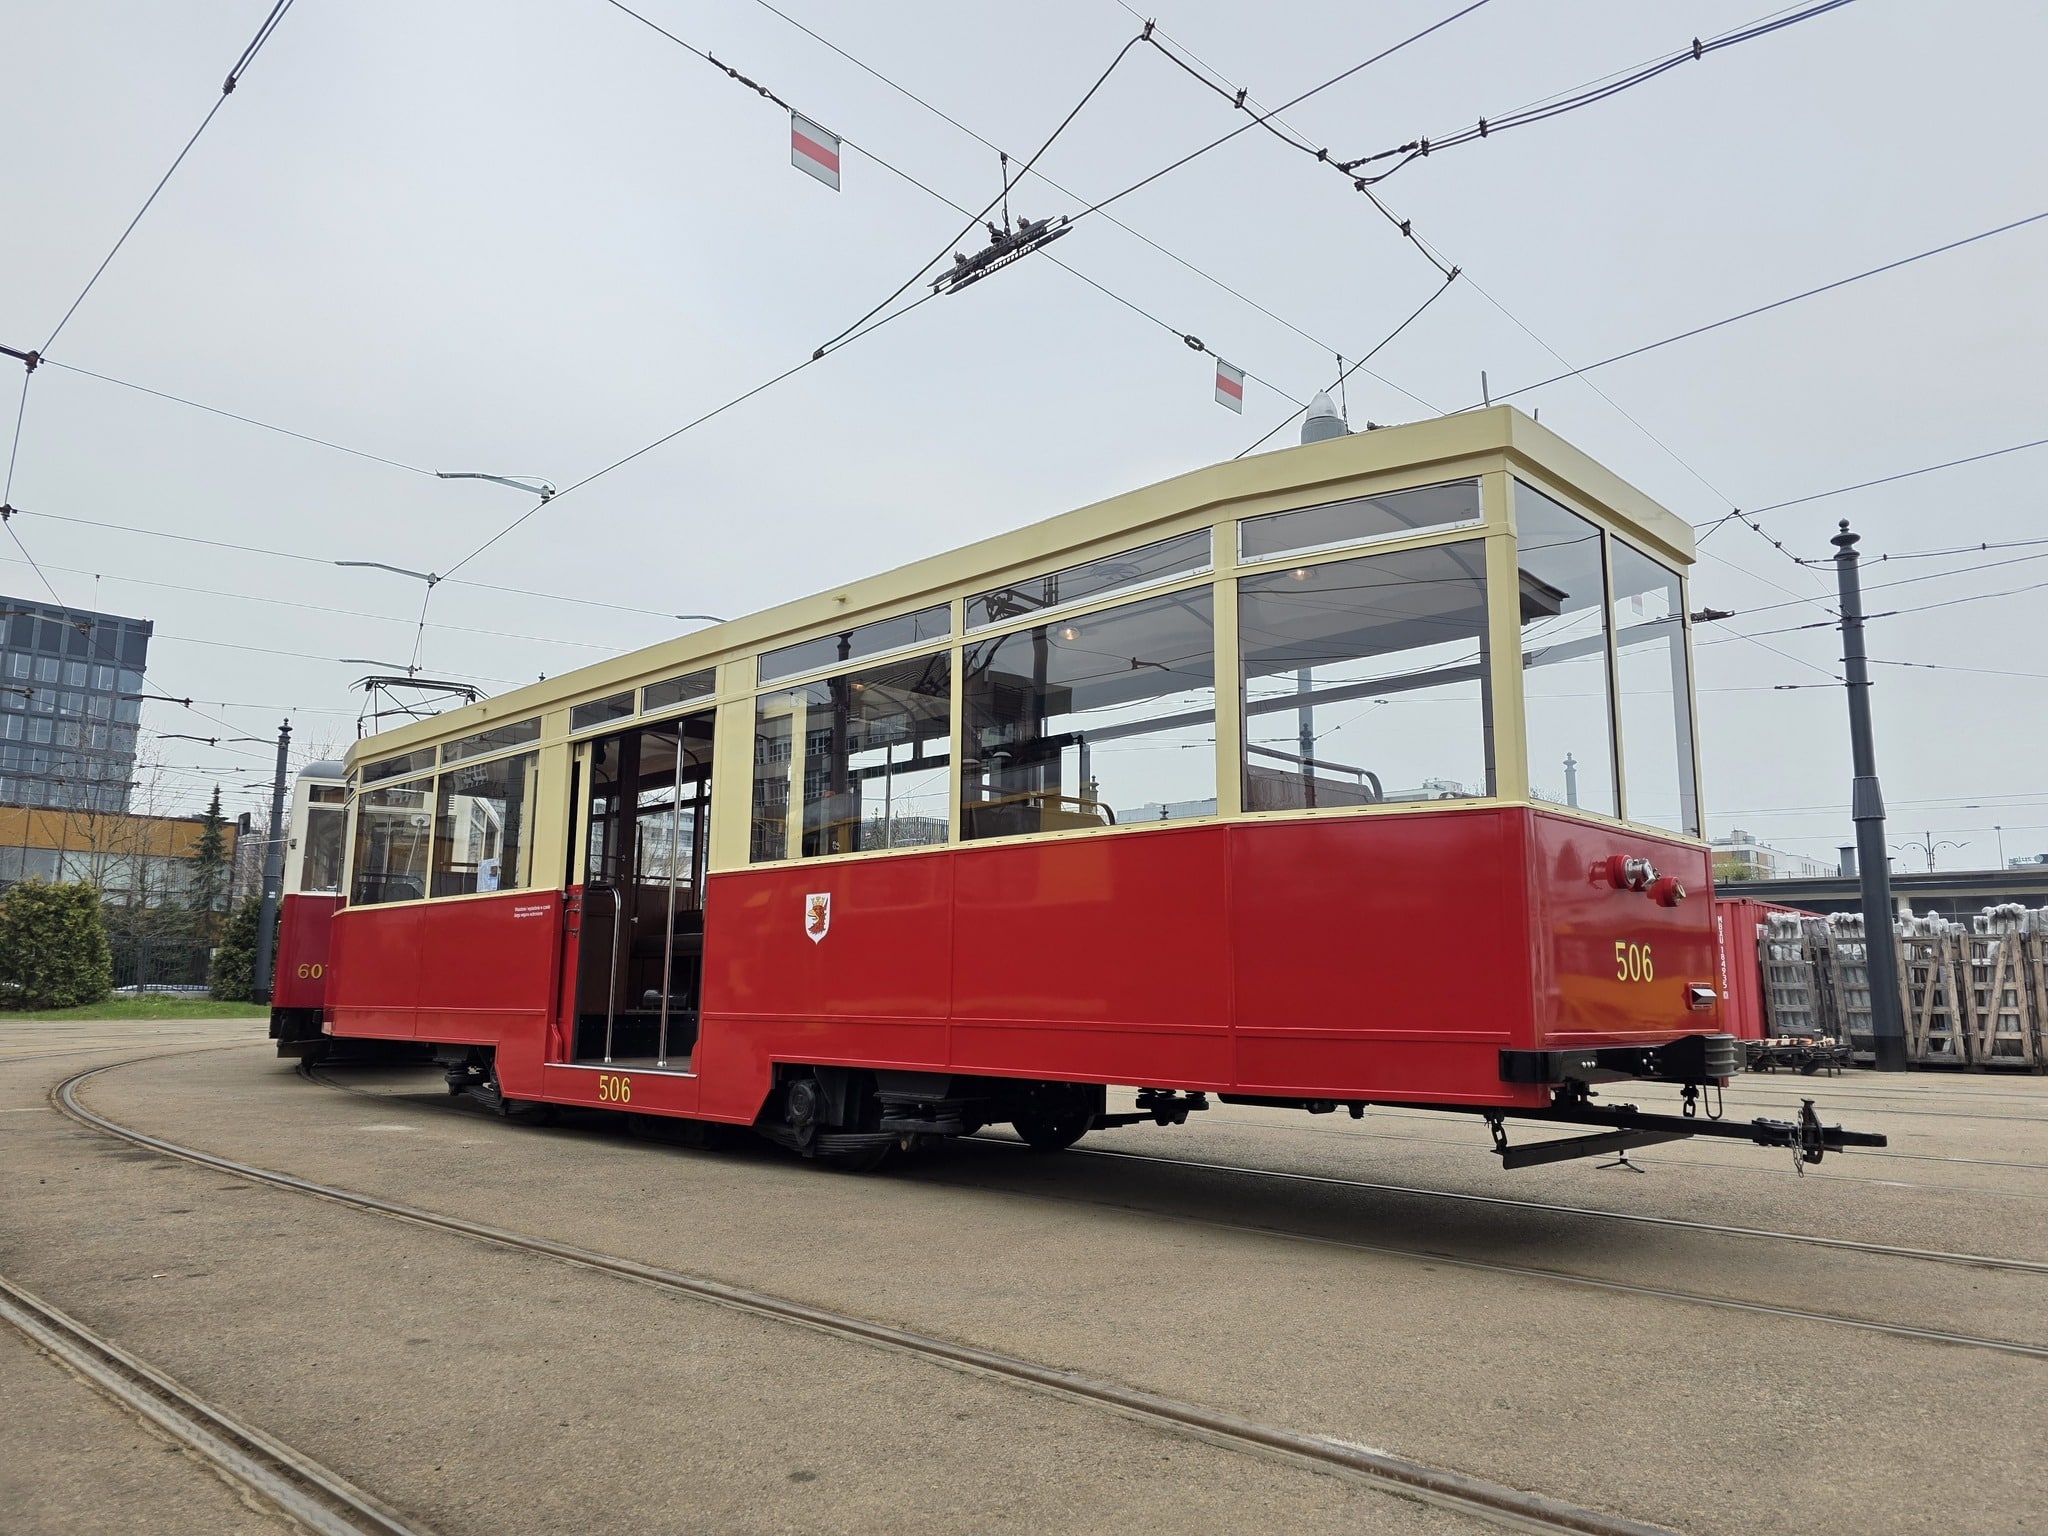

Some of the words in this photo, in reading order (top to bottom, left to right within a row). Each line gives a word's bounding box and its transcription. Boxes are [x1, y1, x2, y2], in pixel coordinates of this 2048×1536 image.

[297, 963, 329, 979] 60
[1615, 940, 1653, 983] 506
[1720, 946, 1728, 989] 184935
[599, 1074, 631, 1103] 506
